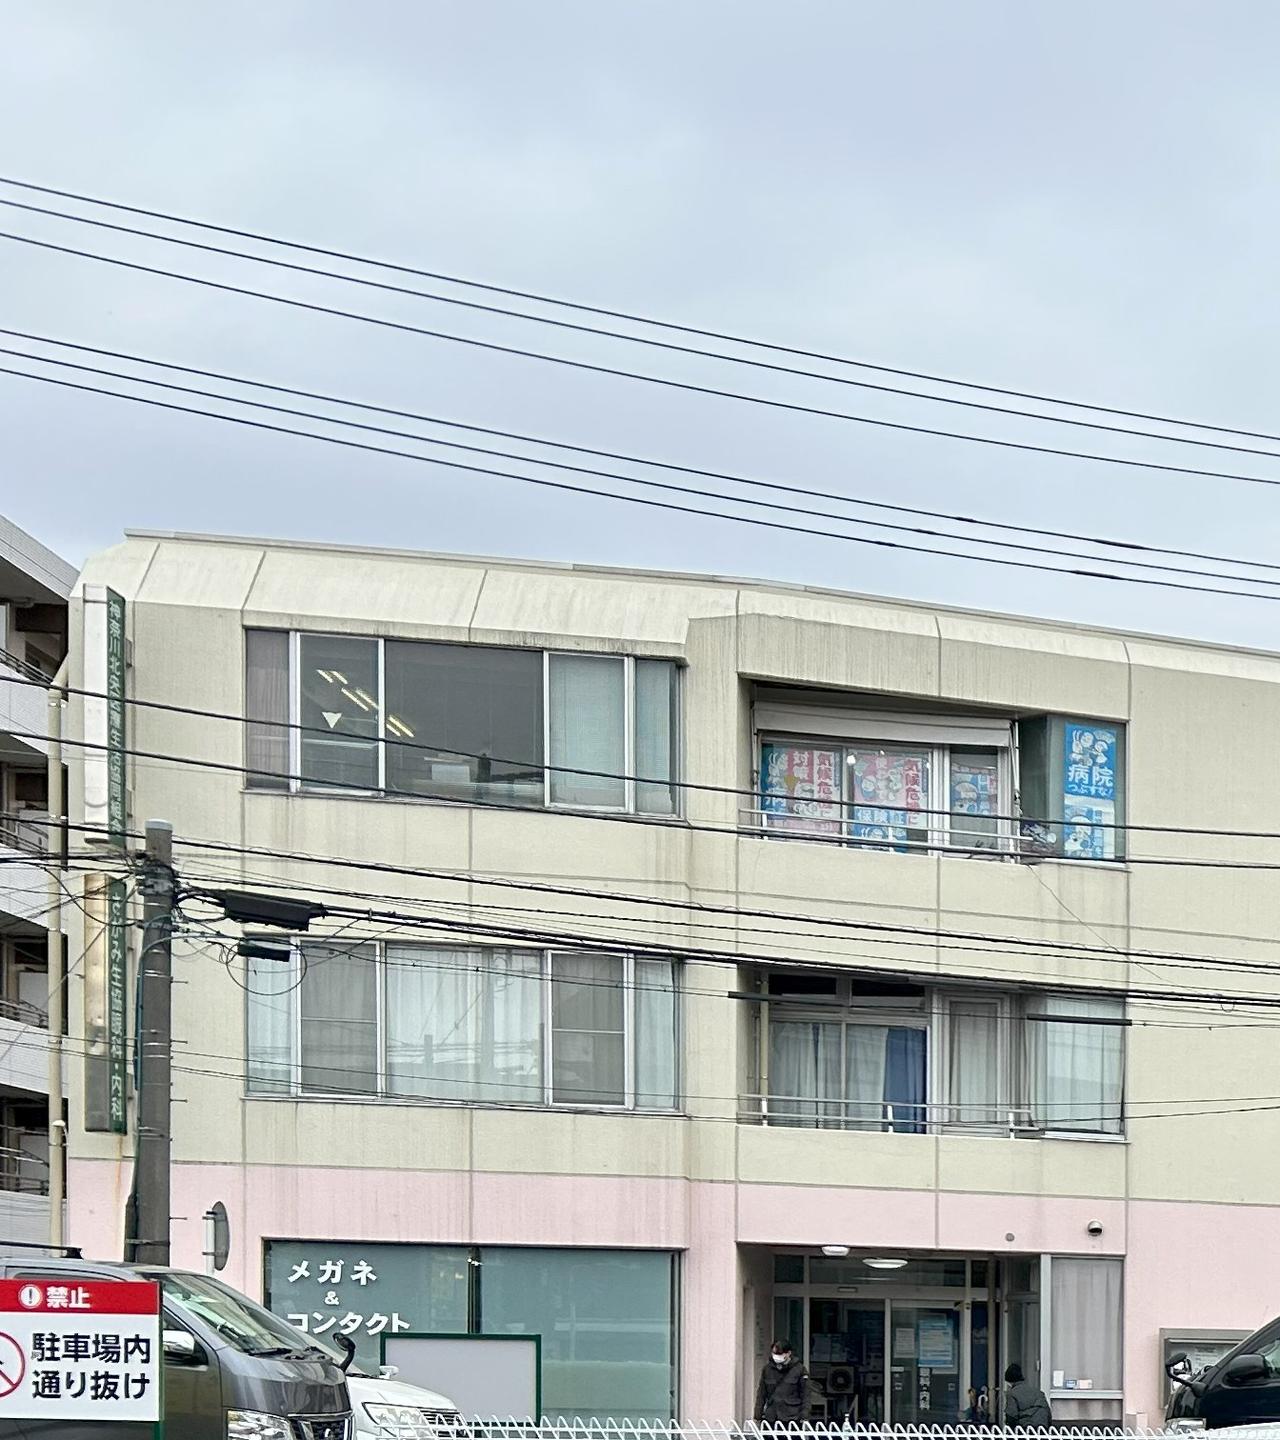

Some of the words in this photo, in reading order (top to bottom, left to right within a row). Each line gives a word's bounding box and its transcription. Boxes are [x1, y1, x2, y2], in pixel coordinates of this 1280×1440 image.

[1068, 763, 1114, 787] 病院
[288, 1260, 377, 1286] メガネ
[46, 1285, 92, 1309] 禁止
[324, 1290, 340, 1306] &
[288, 1311, 411, 1336] コンタクト
[32, 1332, 151, 1364] 駐車場内
[32, 1370, 151, 1400] 通り抜け
